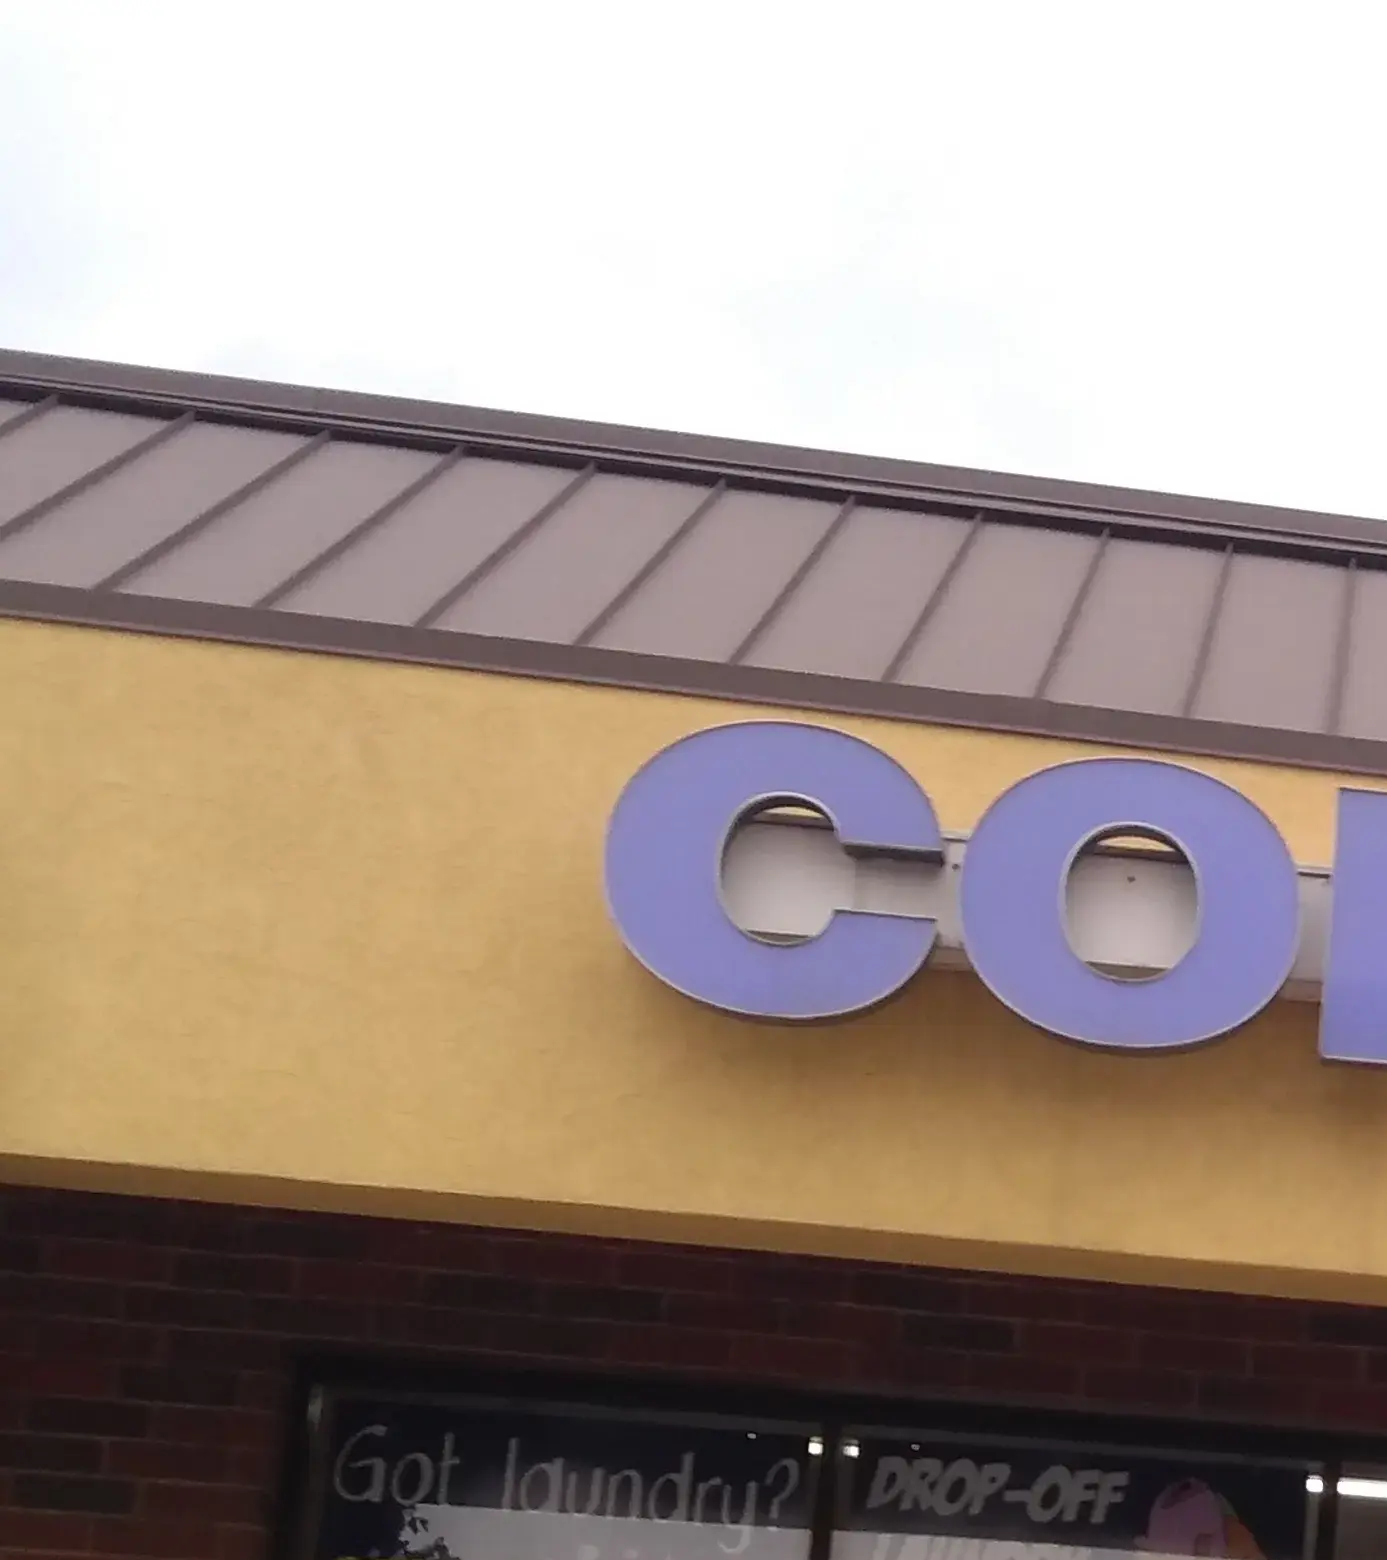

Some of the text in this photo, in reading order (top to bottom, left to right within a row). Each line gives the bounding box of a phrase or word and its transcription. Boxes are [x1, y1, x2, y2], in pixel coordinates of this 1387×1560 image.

[334, 1425, 800, 1554] Got laundry?
[866, 1457, 1130, 1526] DROP-OFF
